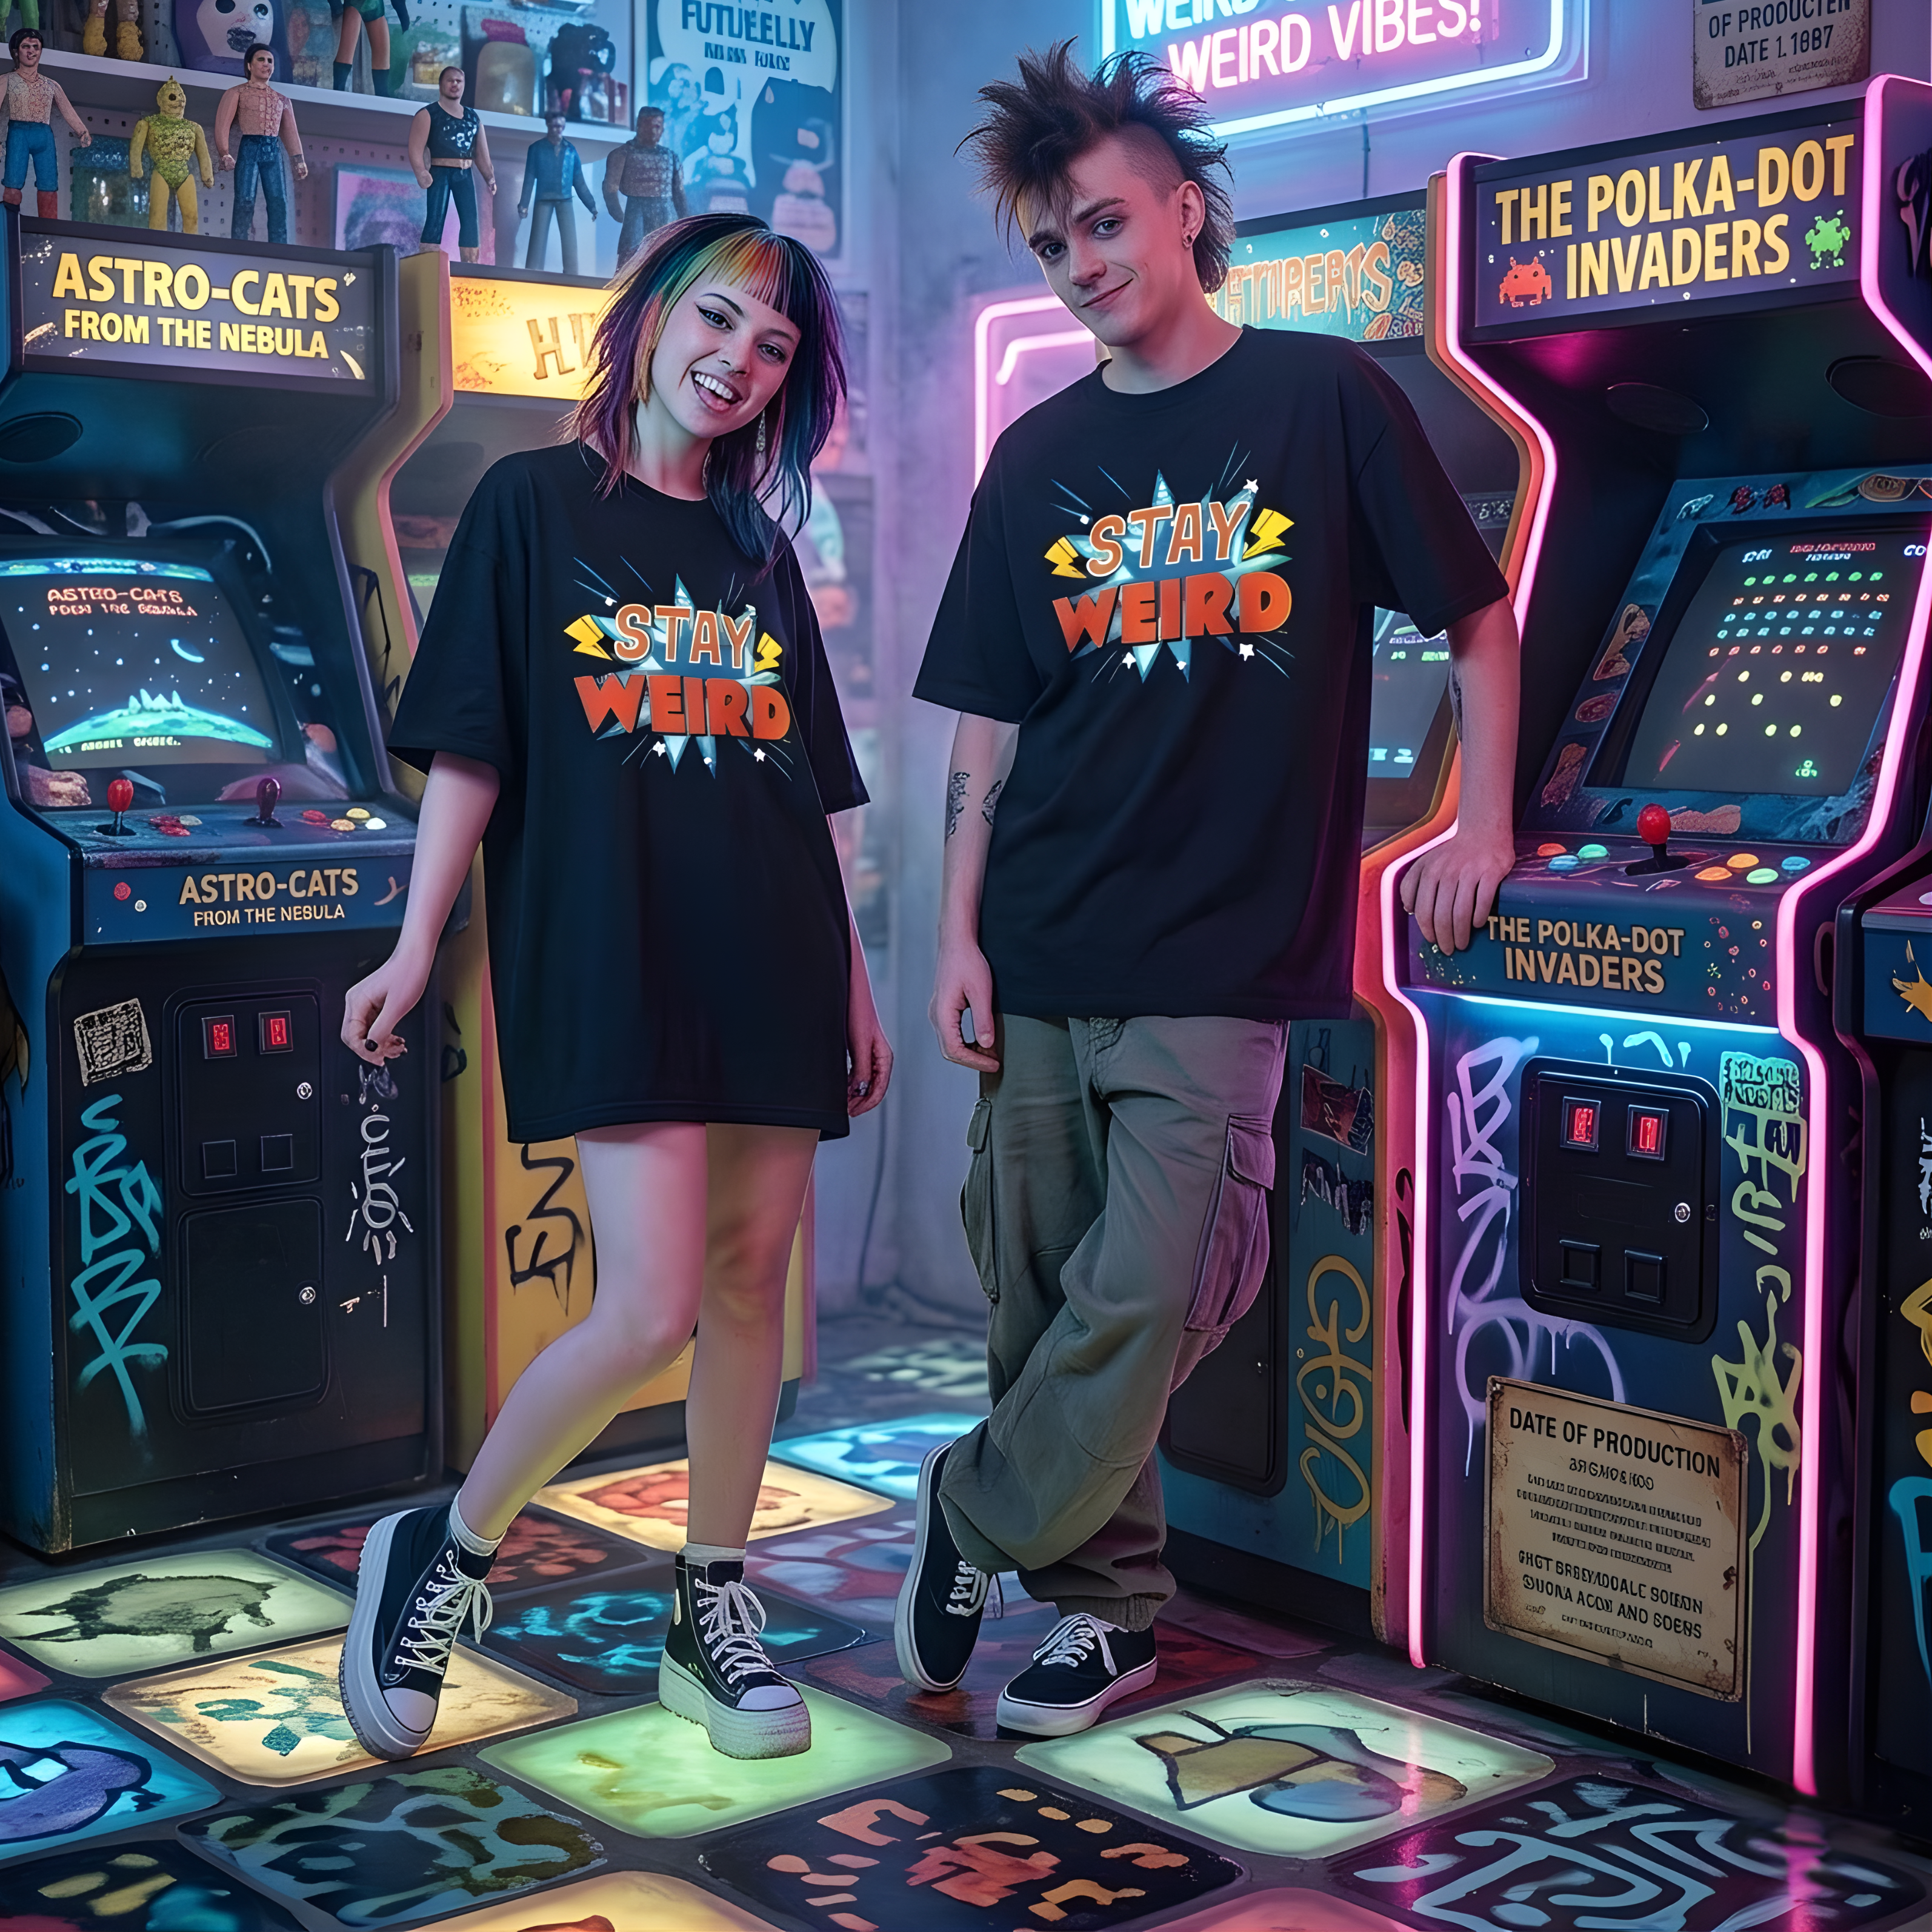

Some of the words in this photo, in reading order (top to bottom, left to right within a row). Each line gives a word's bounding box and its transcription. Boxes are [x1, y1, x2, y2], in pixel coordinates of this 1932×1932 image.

[1168, 13, 1311, 92] WEIRD
[1328, 0, 1482, 61] VIBES!
[1709, 13, 1731, 38] OF
[1725, 38, 1768, 68] DATE
[1496, 180, 1573, 244] THE
[1588, 134, 1854, 232] POLKA-DOT
[52, 253, 341, 322] ASTRO-CATS
[1567, 213, 1790, 299] INVADERS
[64, 308, 150, 344] FROM
[158, 318, 211, 350] THE
[221, 325, 329, 359] NEBULA
[1086, 502, 1251, 577] STAY
[614, 604, 753, 668] STAY
[1052, 571, 1292, 653] WEIRD
[573, 673, 790, 740] WEIRD
[179, 868, 359, 905] ASTRO-CATS
[194, 910, 240, 926] FROM
[244, 907, 276, 923] THE
[1488, 916, 1530, 942] THE
[1538, 919, 1685, 956] POLKA-DOT
[1505, 947, 1665, 994] INVADERS
[1510, 1407, 1556, 1438] DATE
[1563, 1421, 1588, 1444] OF
[1594, 1428, 1720, 1479] PRODUCTION
